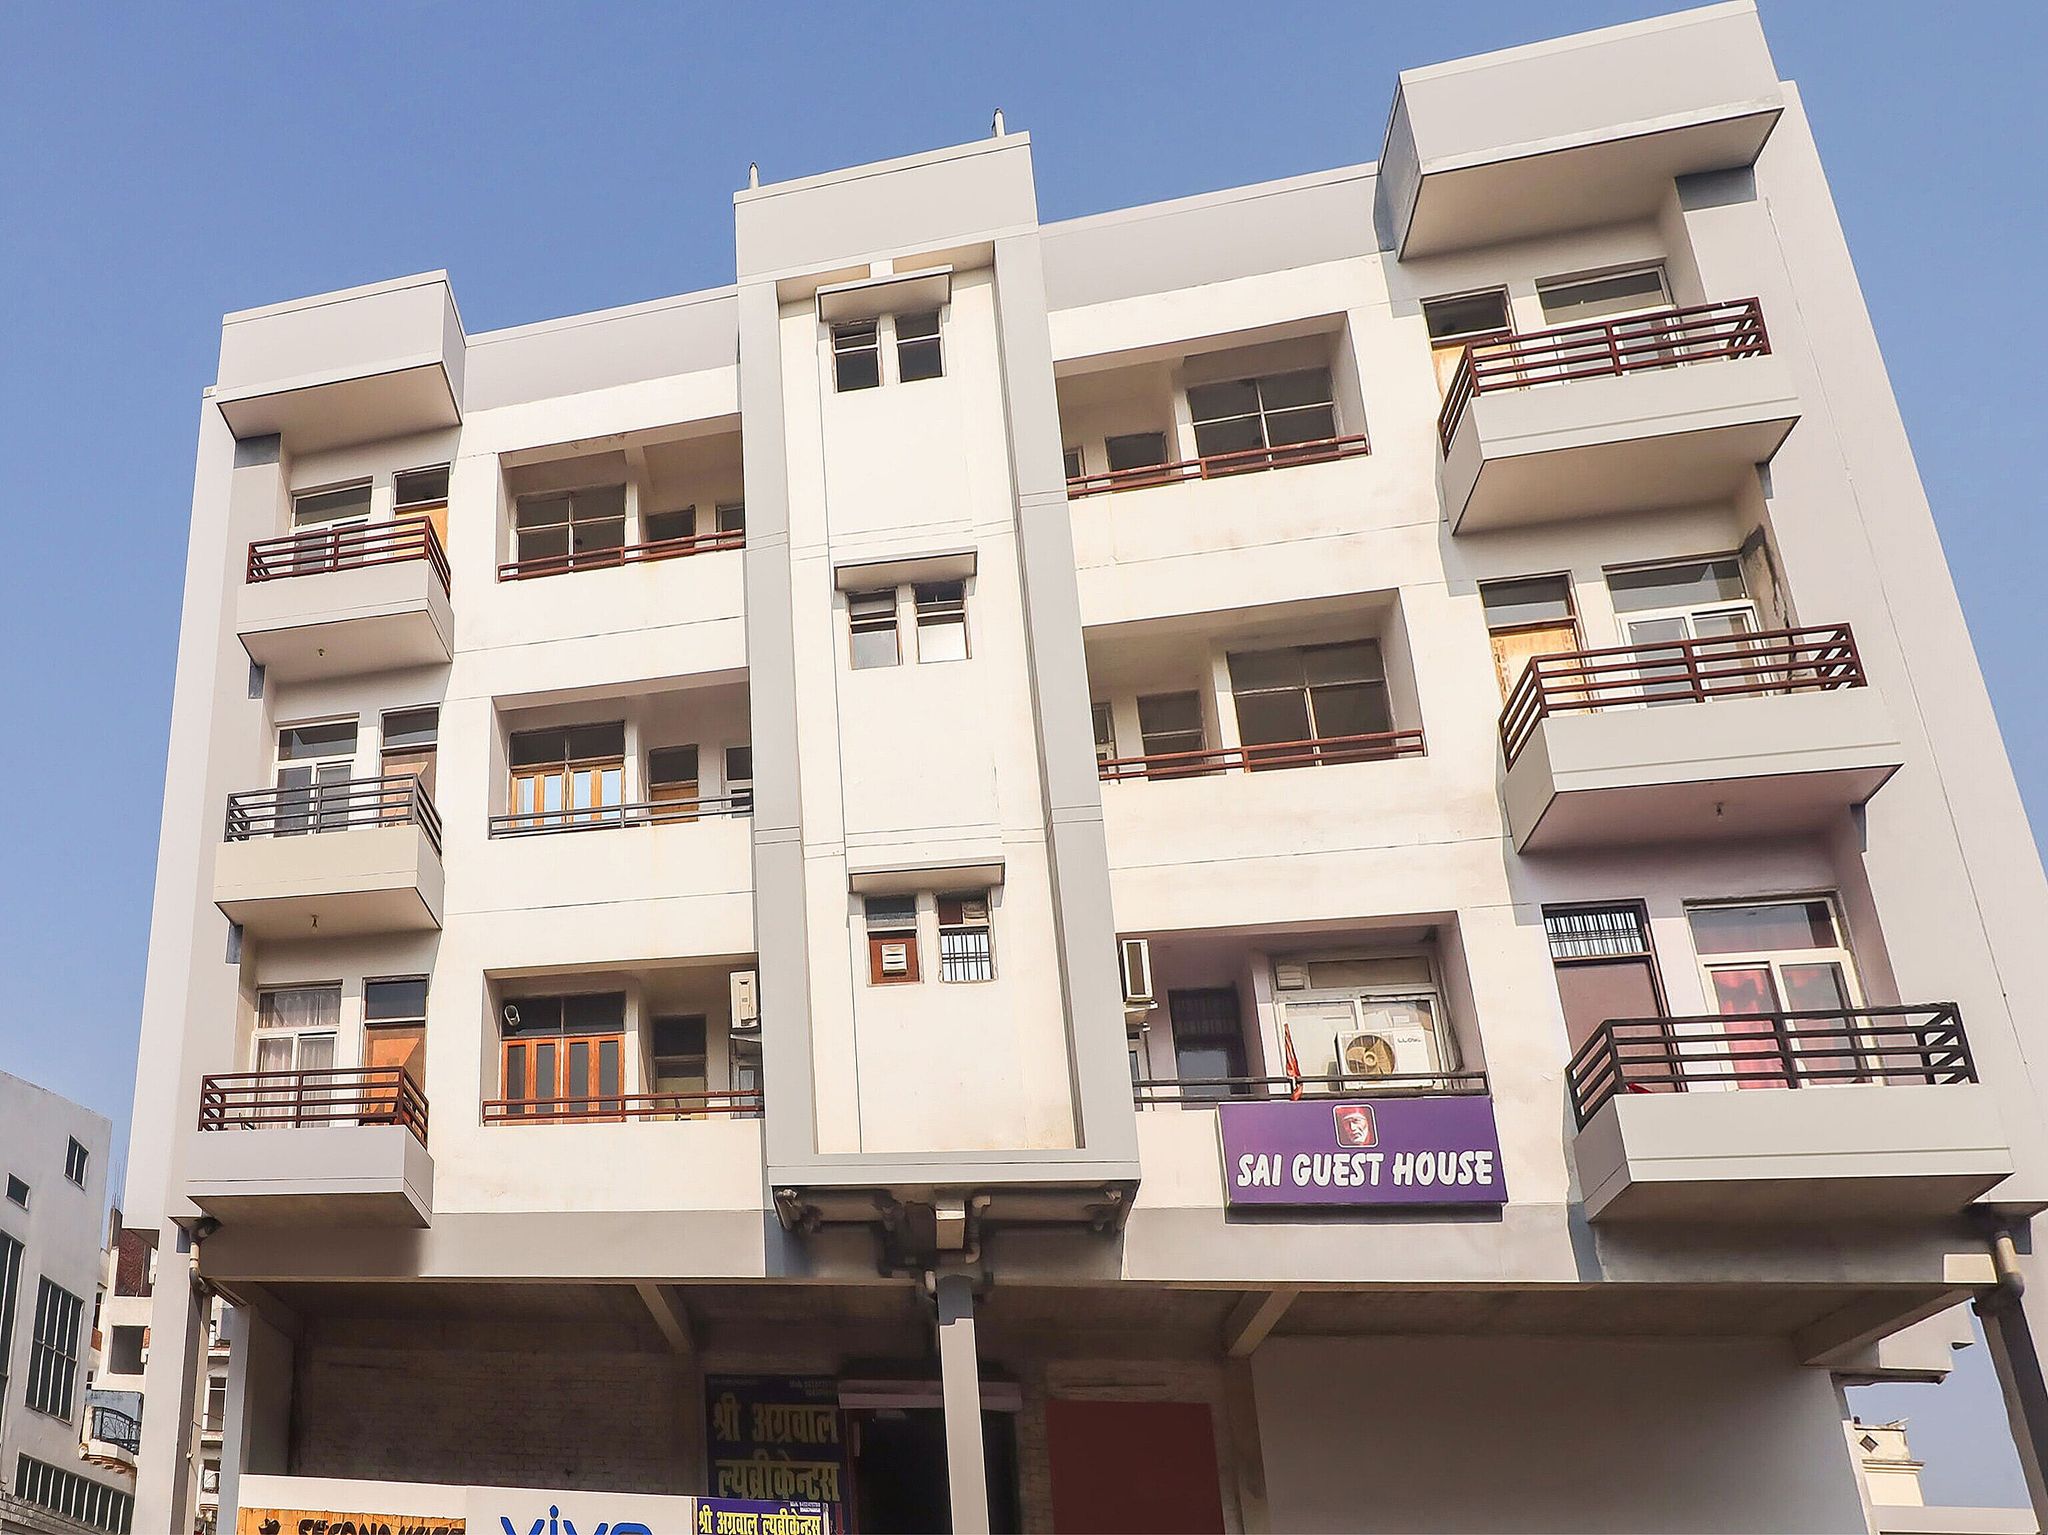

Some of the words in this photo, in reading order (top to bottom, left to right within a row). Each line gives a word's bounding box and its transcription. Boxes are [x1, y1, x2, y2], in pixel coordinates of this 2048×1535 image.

[1236, 1153, 1283, 1187] SAI
[1291, 1151, 1385, 1187] GUEST
[1392, 1150, 1494, 1186] HOUSE
[713, 1391, 741, 1441] श्री
[751, 1402, 837, 1444] अग्रवाल
[699, 1504, 713, 1534] श्री
[717, 1511, 759, 1535] अग्रवाल
